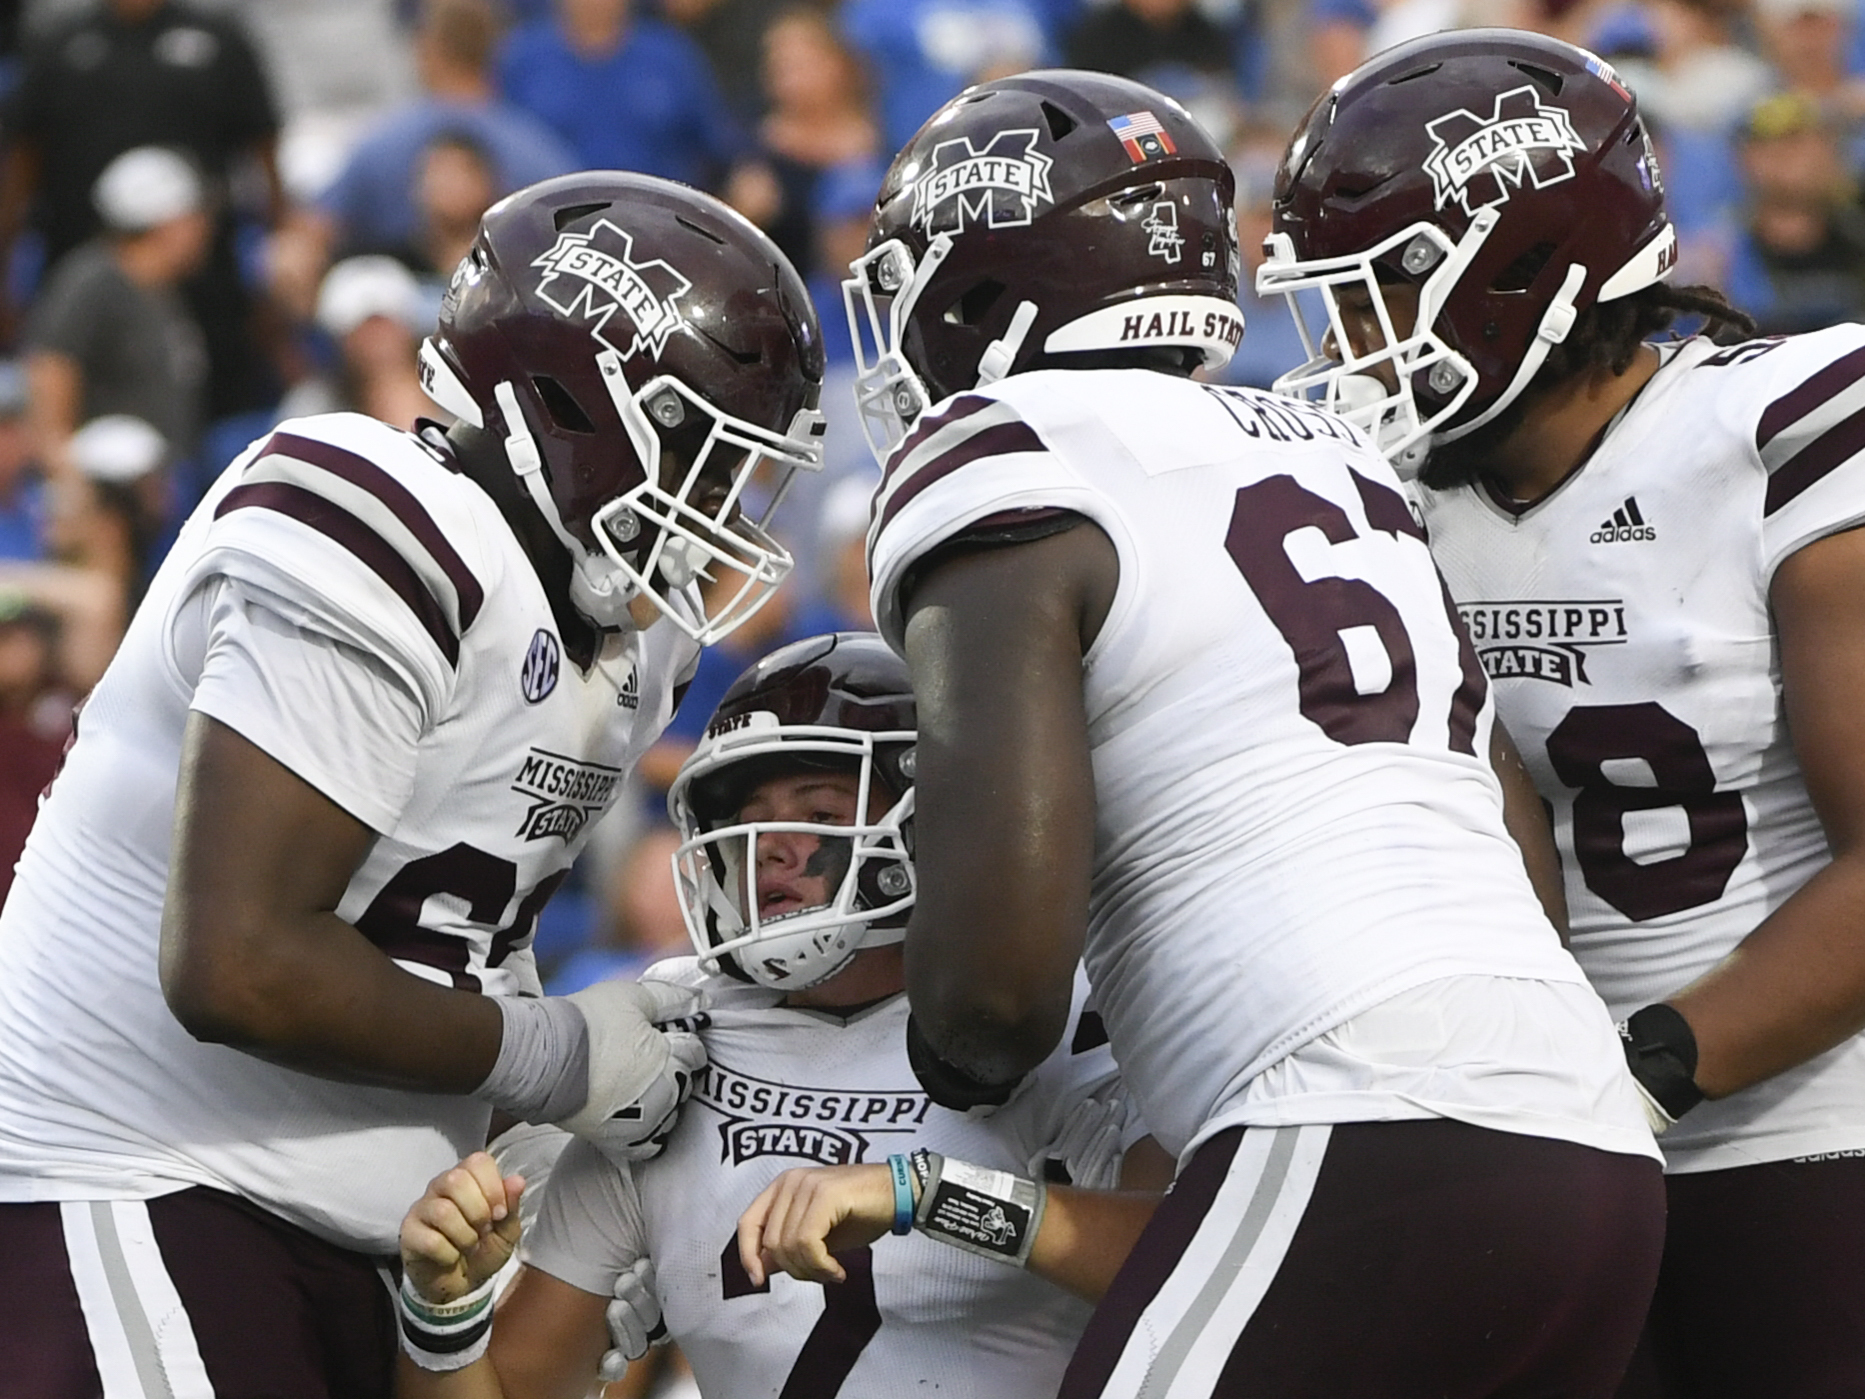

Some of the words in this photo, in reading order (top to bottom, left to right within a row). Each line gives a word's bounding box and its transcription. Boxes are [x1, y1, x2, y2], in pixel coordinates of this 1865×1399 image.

[1455, 122, 1550, 174] STATE
[934, 161, 1021, 199] STATE
[1202, 252, 1216, 267] 67
[569, 252, 655, 324] STATE
[1119, 311, 1195, 341] HAIL
[1203, 312, 1245, 353] STAT
[1589, 526, 1657, 544] adidas
[1224, 463, 1494, 758] 67
[523, 630, 558, 701] SEC
[740, 1129, 842, 1162] STATE
